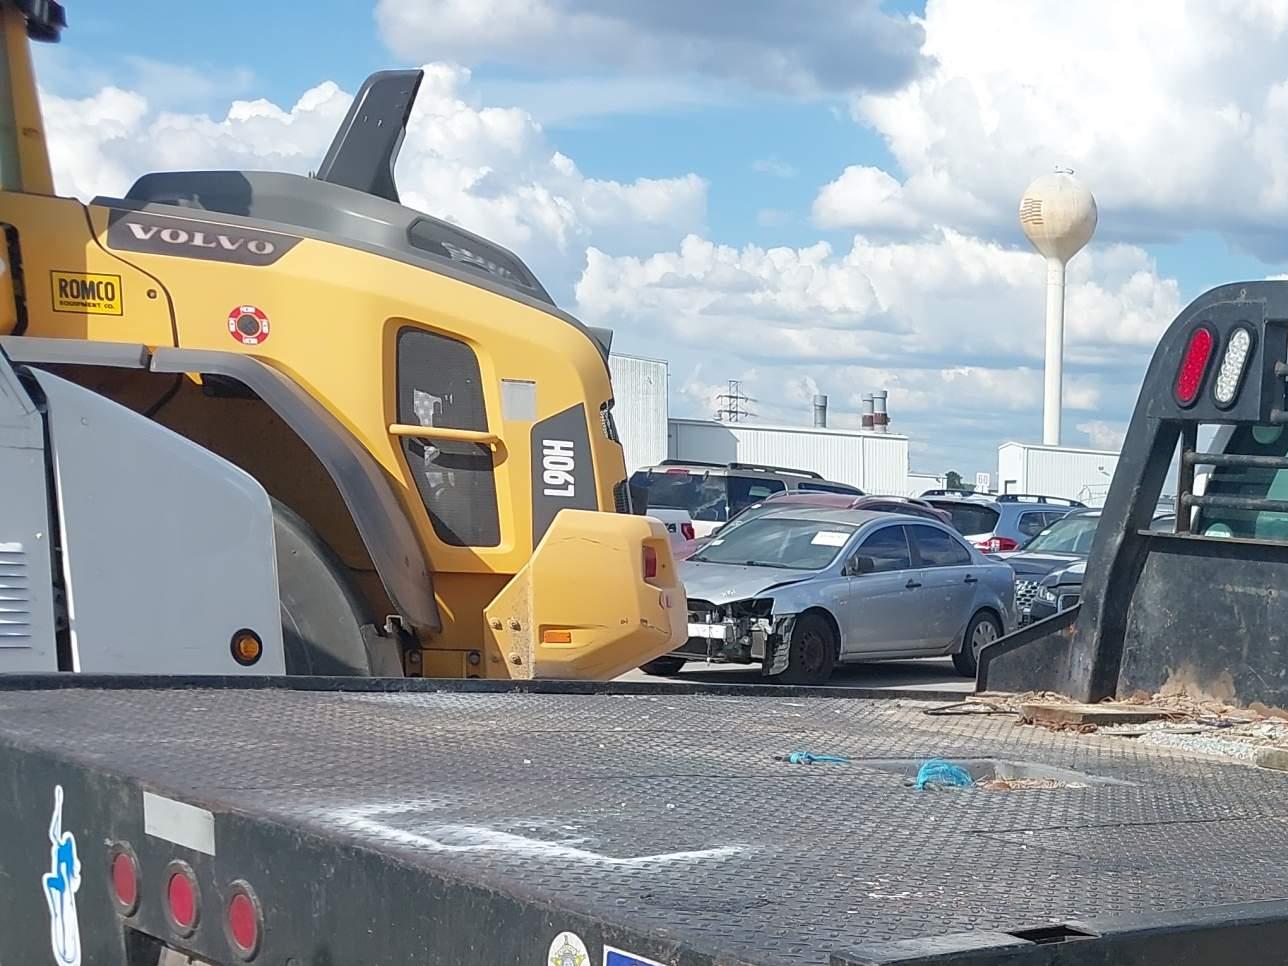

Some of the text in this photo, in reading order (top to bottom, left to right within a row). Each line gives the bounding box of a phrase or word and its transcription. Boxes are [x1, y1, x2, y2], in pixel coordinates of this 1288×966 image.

[127, 223, 275, 254] VOLVO
[58, 278, 116, 301] ROMCO
[542, 439, 575, 497] L90H
